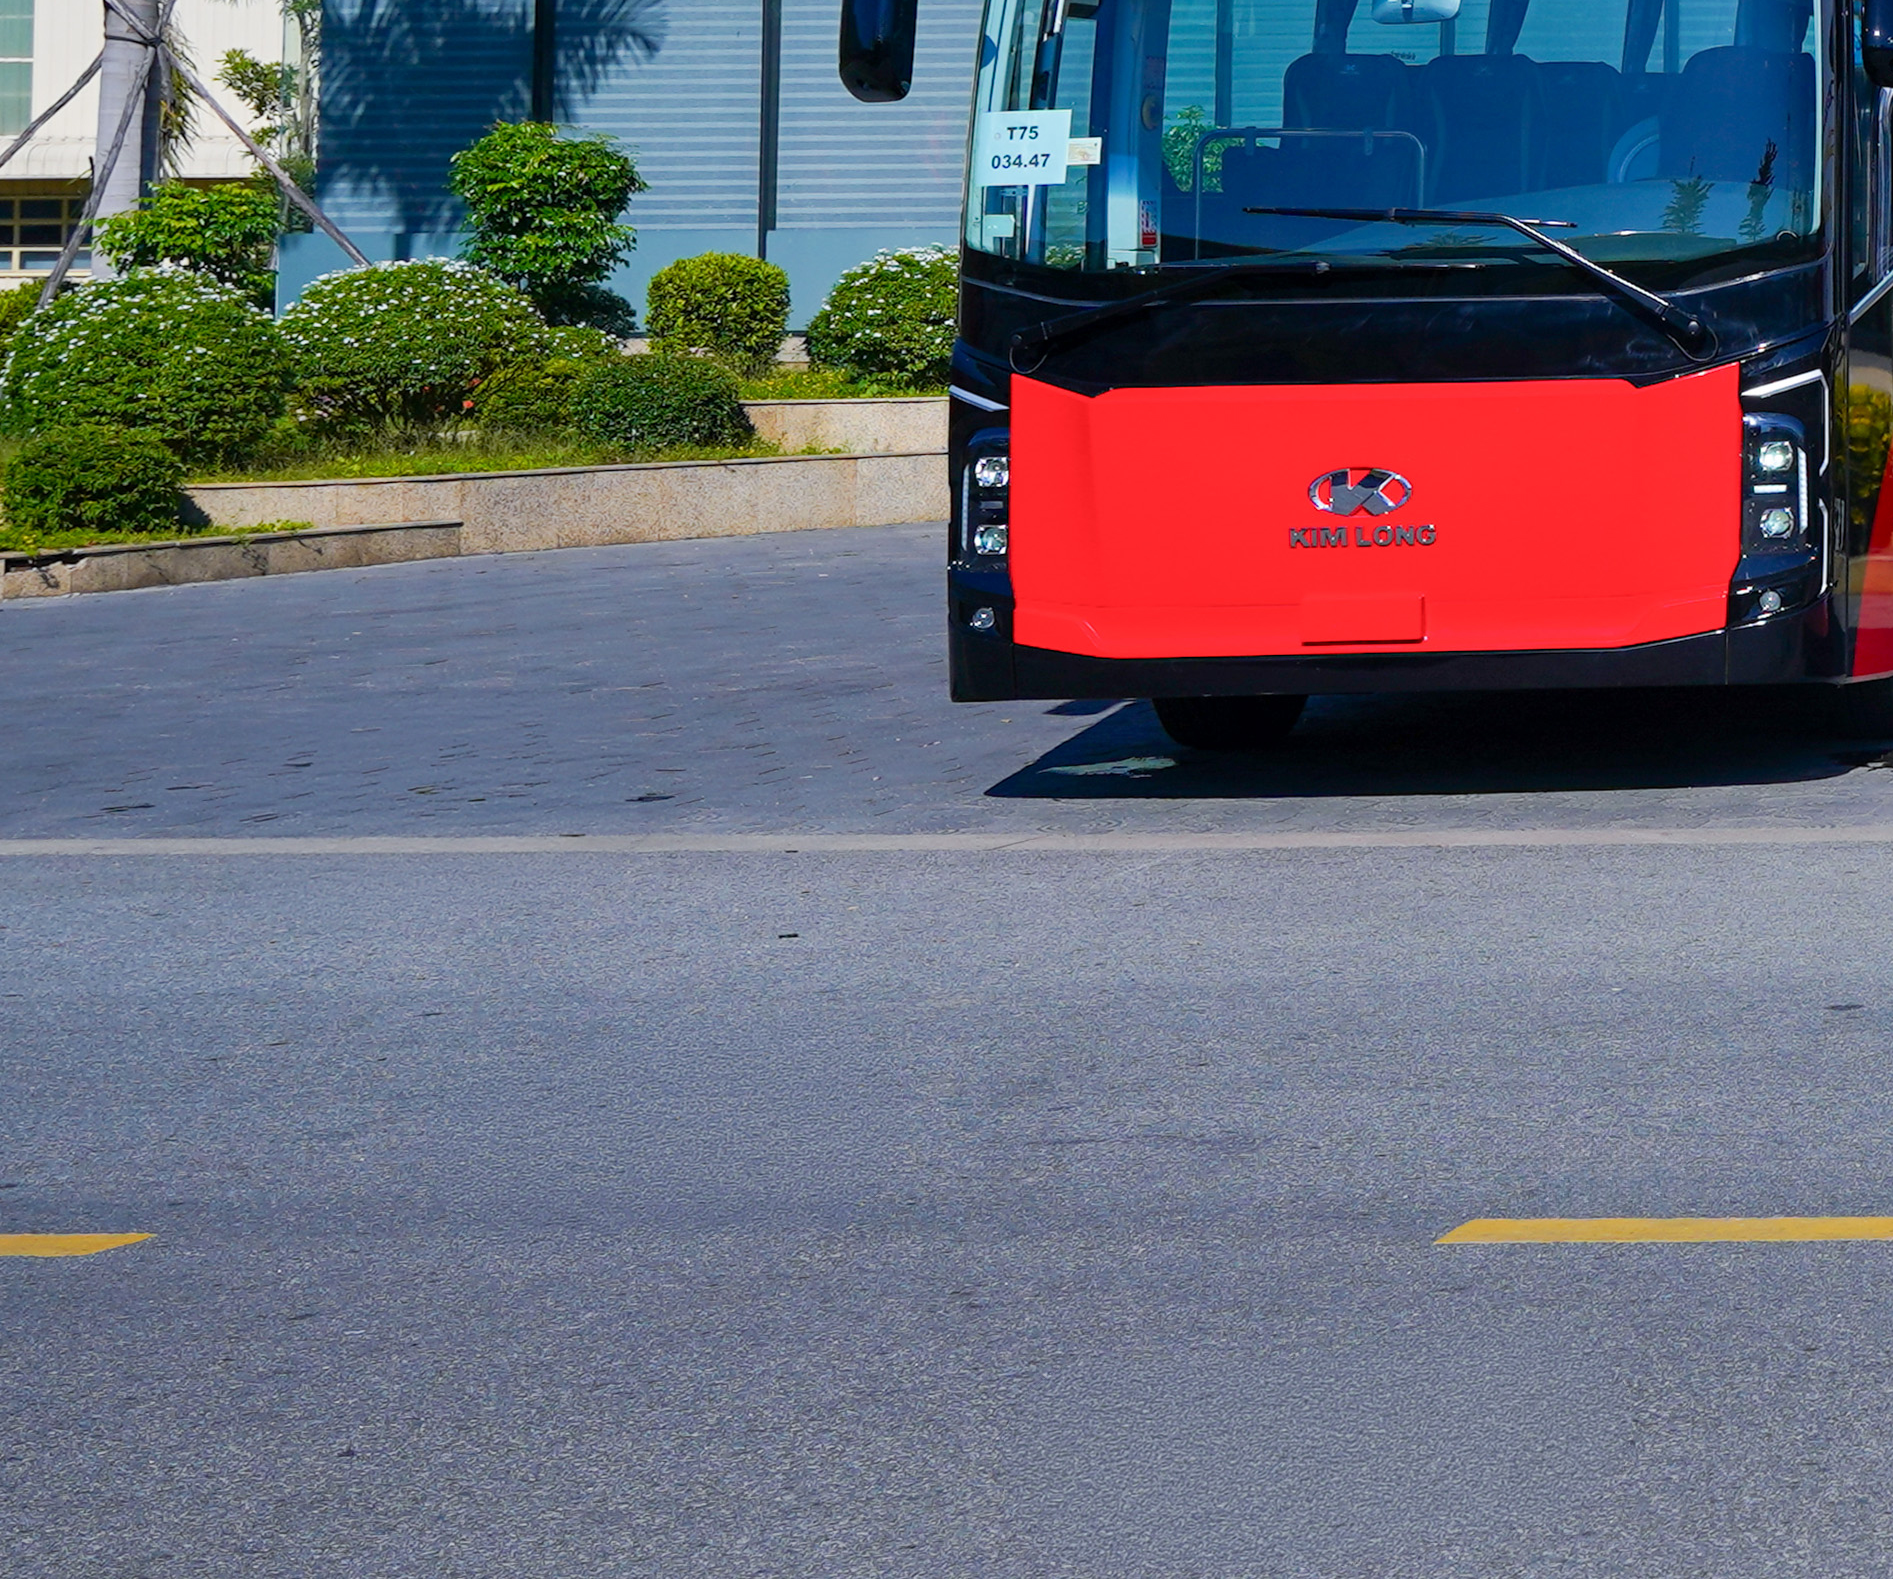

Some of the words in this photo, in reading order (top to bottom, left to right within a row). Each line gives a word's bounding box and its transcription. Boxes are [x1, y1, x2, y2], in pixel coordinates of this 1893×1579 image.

[1006, 125, 1039, 141] T75
[991, 153, 1051, 170] 034.47
[1289, 526, 1349, 549] KIM
[1356, 523, 1437, 548] LONG
